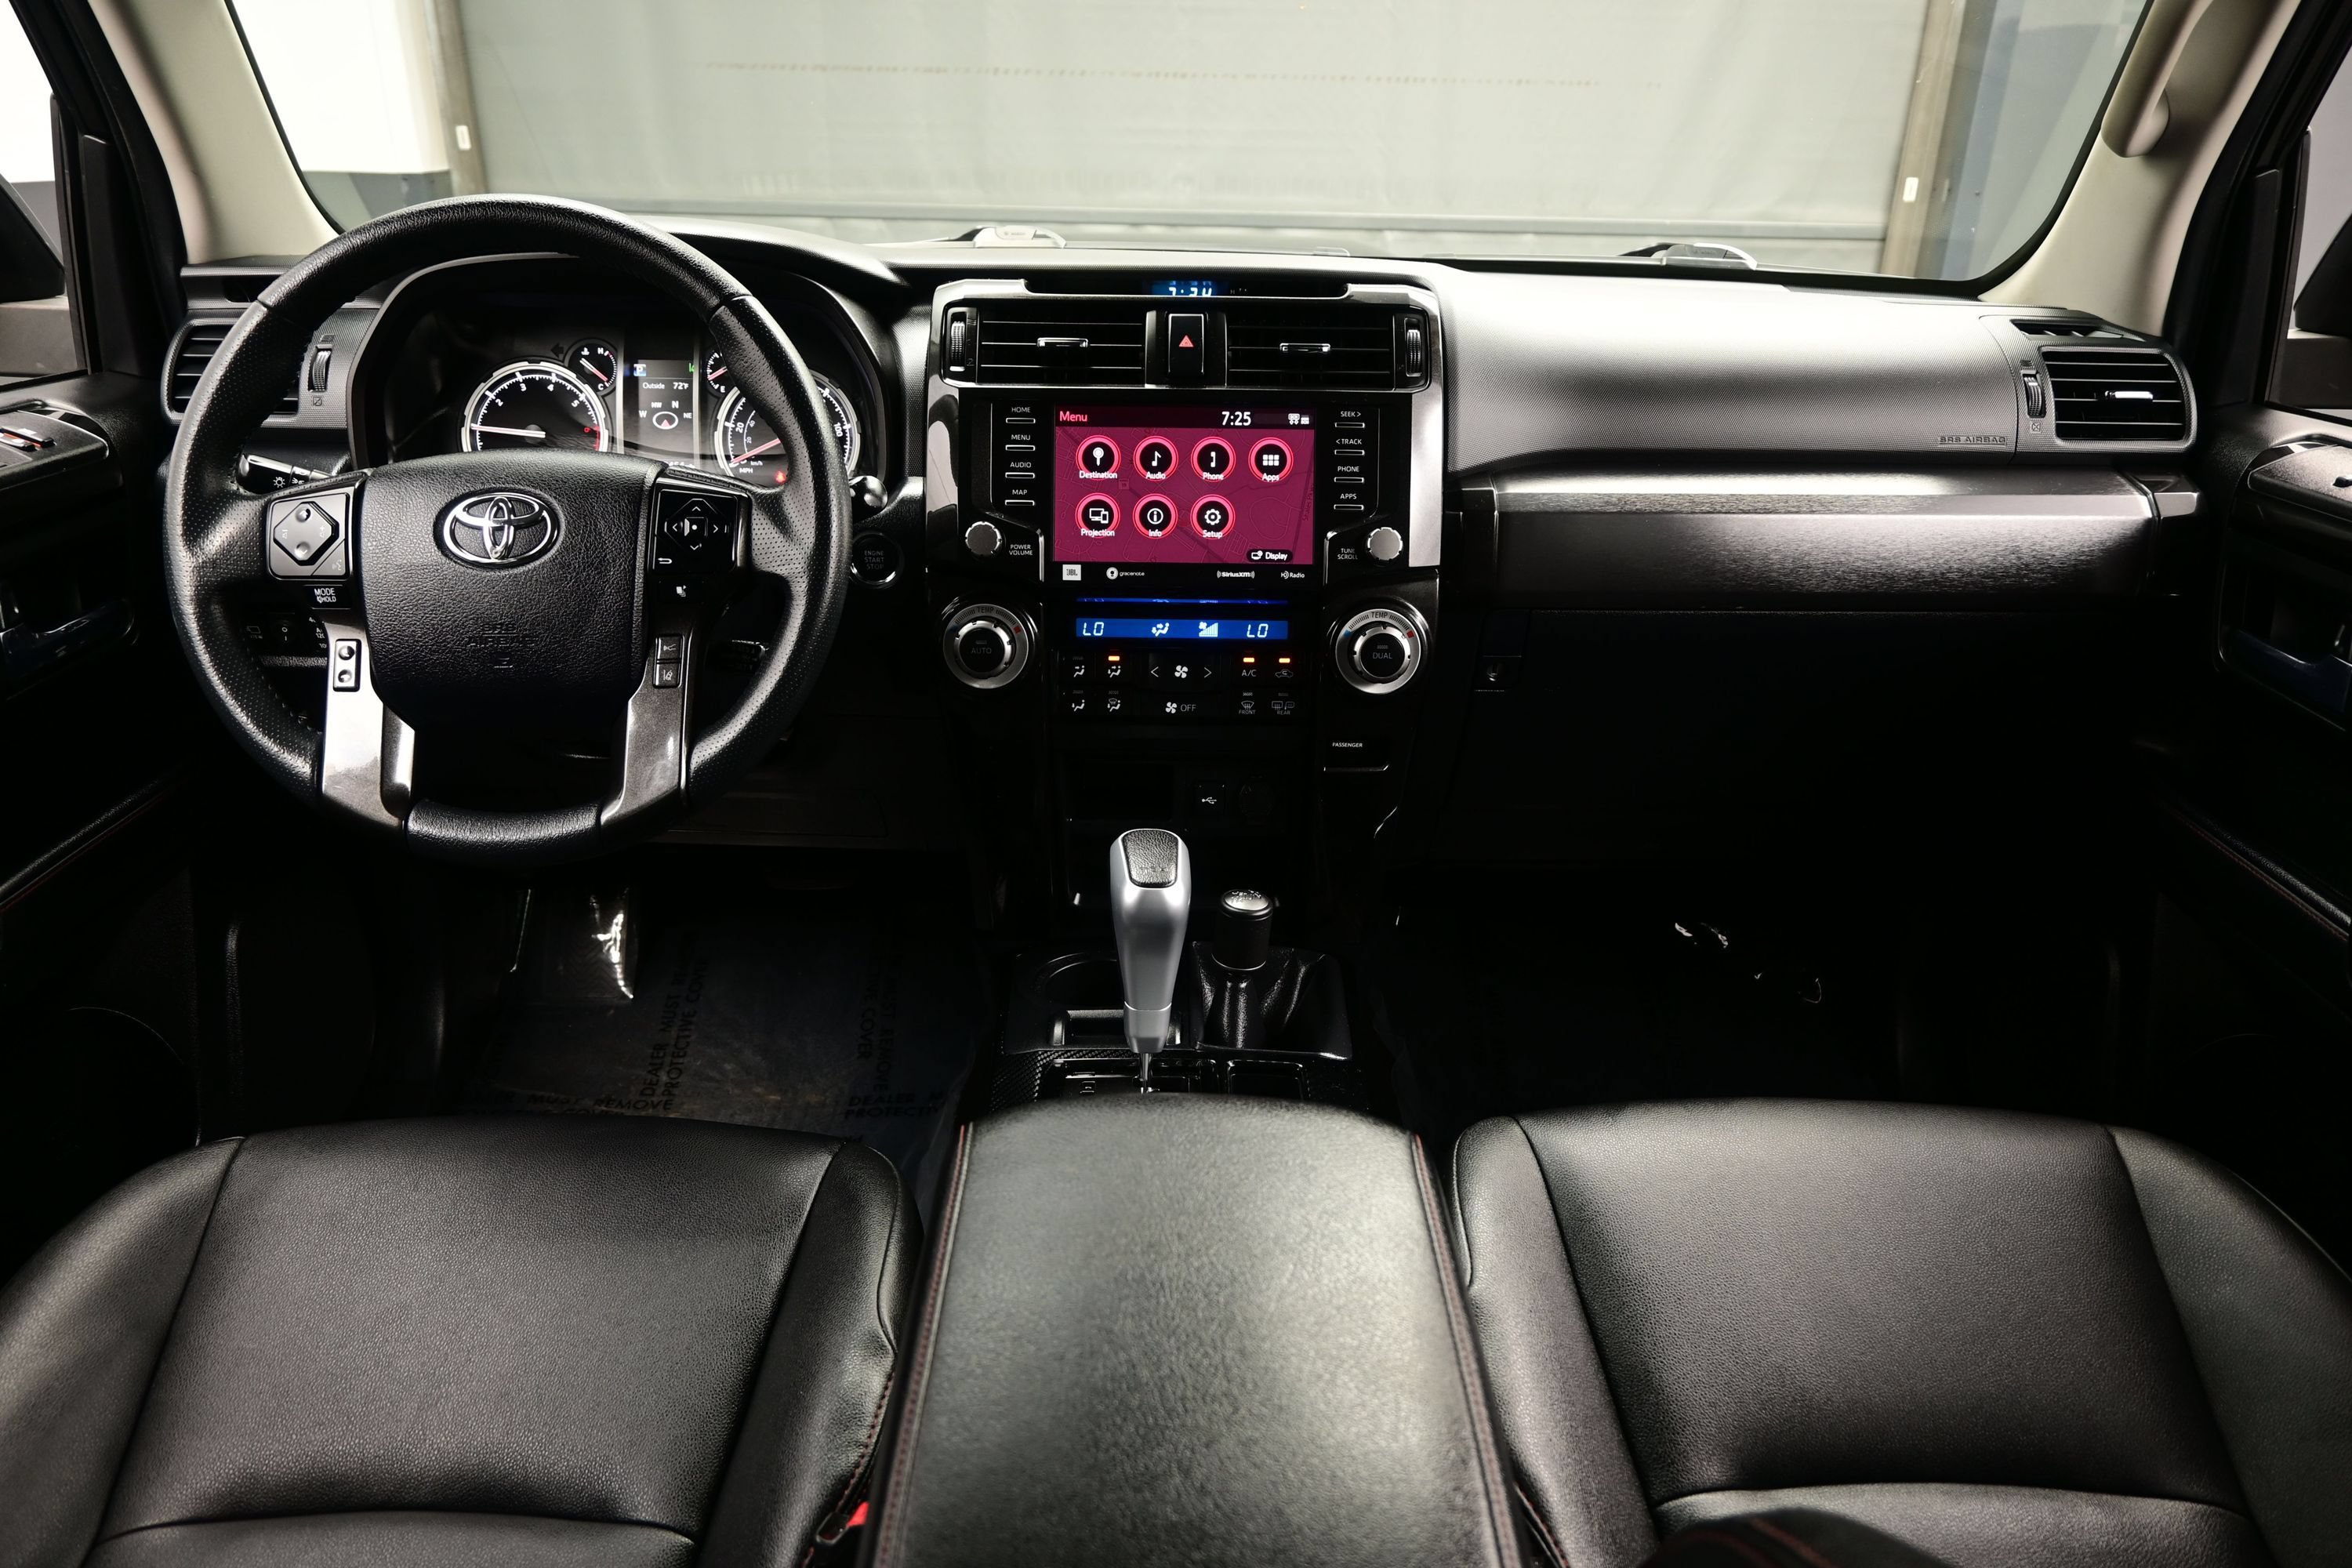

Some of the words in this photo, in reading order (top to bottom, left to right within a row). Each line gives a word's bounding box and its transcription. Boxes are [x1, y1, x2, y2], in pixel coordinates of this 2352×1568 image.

[520, 383, 527, 392] 3
[547, 384, 554, 392] 4
[495, 399, 503, 407] 2
[571, 399, 580, 408] 5
[671, 400, 679, 408] N
[1060, 411, 1088, 422] Menu
[1221, 411, 1251, 426] 7:25
[736, 421, 744, 434] 20
[833, 421, 844, 438] 100
[1079, 470, 1118, 480] Destination
[1145, 471, 1166, 480] Audio
[1203, 471, 1224, 481] Phone
[1262, 472, 1280, 482] Apps
[1080, 528, 1115, 538] Projection
[1149, 528, 1163, 538] Info
[1203, 529, 1223, 539] Setup
[1265, 551, 1288, 561] Display
[314, 587, 336, 596] MODE
[1241, 668, 1258, 678] A/C
[1180, 703, 1197, 712] OFF
[857, 1008, 877, 1060] COVER
[640, 1042, 670, 1097] DEALER
[659, 993, 681, 1033] MUST
[662, 1009, 698, 1098] PROTECTIVE
[593, 1098, 674, 1111] REMOVE
[848, 1092, 916, 1107] DEALER
